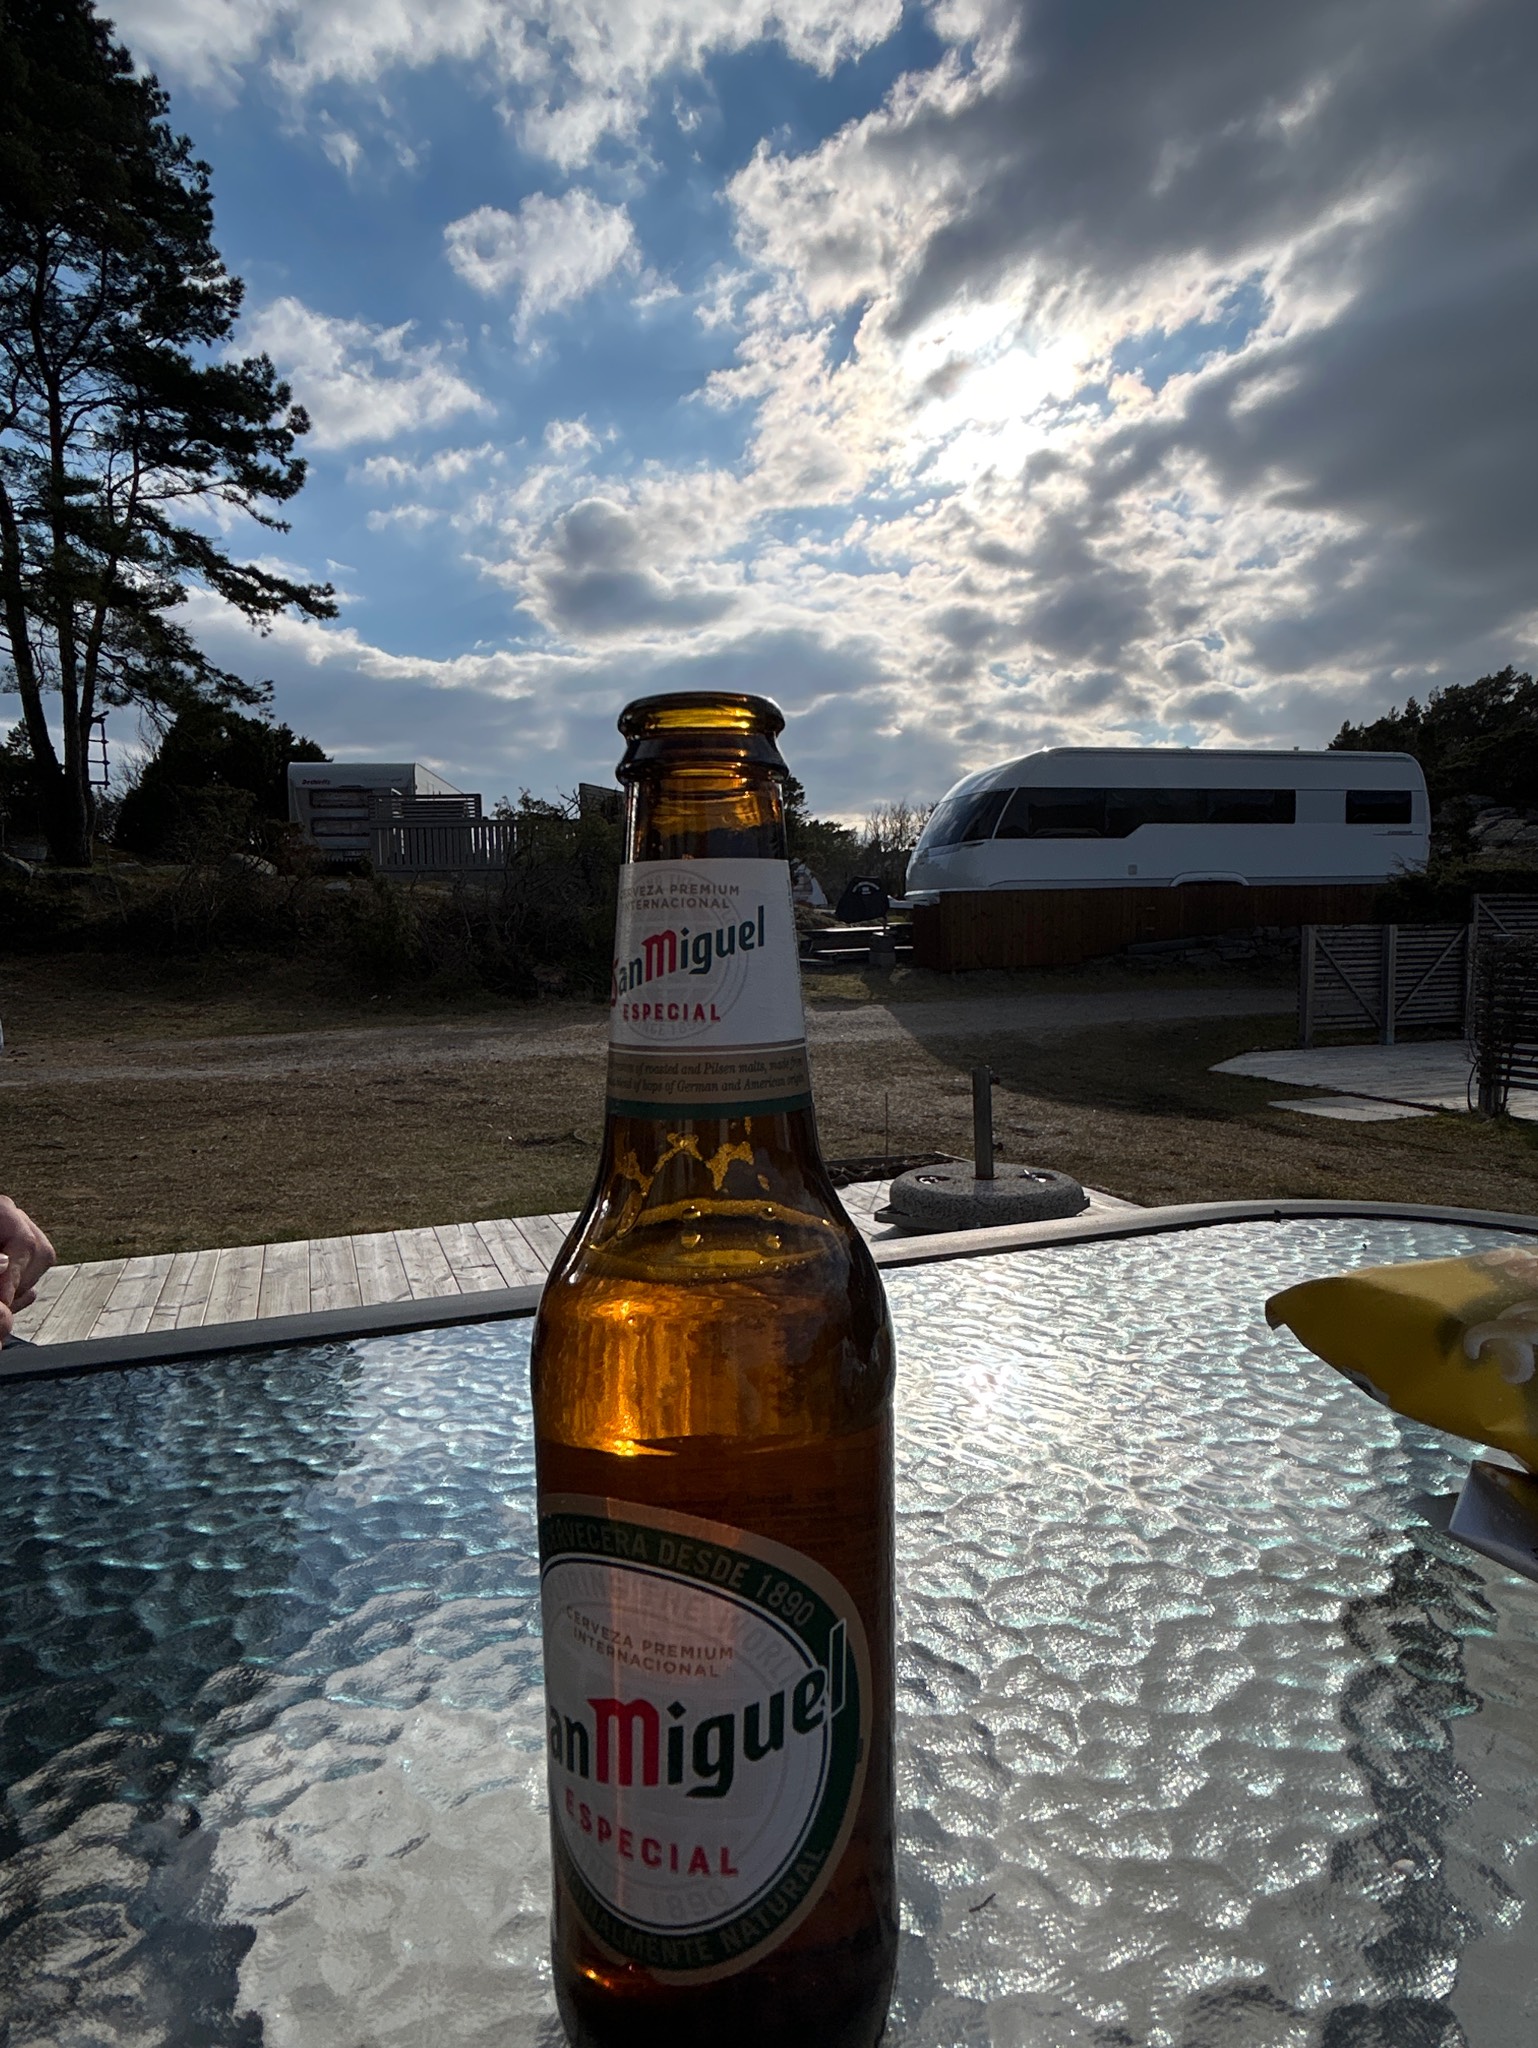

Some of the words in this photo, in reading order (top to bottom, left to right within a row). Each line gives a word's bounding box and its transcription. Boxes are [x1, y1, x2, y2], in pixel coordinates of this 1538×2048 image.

[670, 884, 740, 896] PREMIUM
[623, 1003, 721, 1022] ESPECIAL
[645, 1063, 679, 1075] roasted
[681, 1063, 701, 1075] and
[703, 1062, 736, 1075] Pilsen
[665, 1080, 676, 1094] of
[677, 1079, 718, 1093] German
[721, 1079, 741, 1092] and
[743, 1075, 785, 1091] American
[658, 1537, 750, 1589] DESDE
[755, 1574, 816, 1626] 1890
[566, 1605, 632, 1649] CERVEZA
[642, 1639, 734, 1661] PREMIUM
[573, 1626, 720, 1678] INTERNACIONAL
[565, 1788, 739, 1878] ESPECIAL
[718, 1848, 828, 1953] NATURAL
